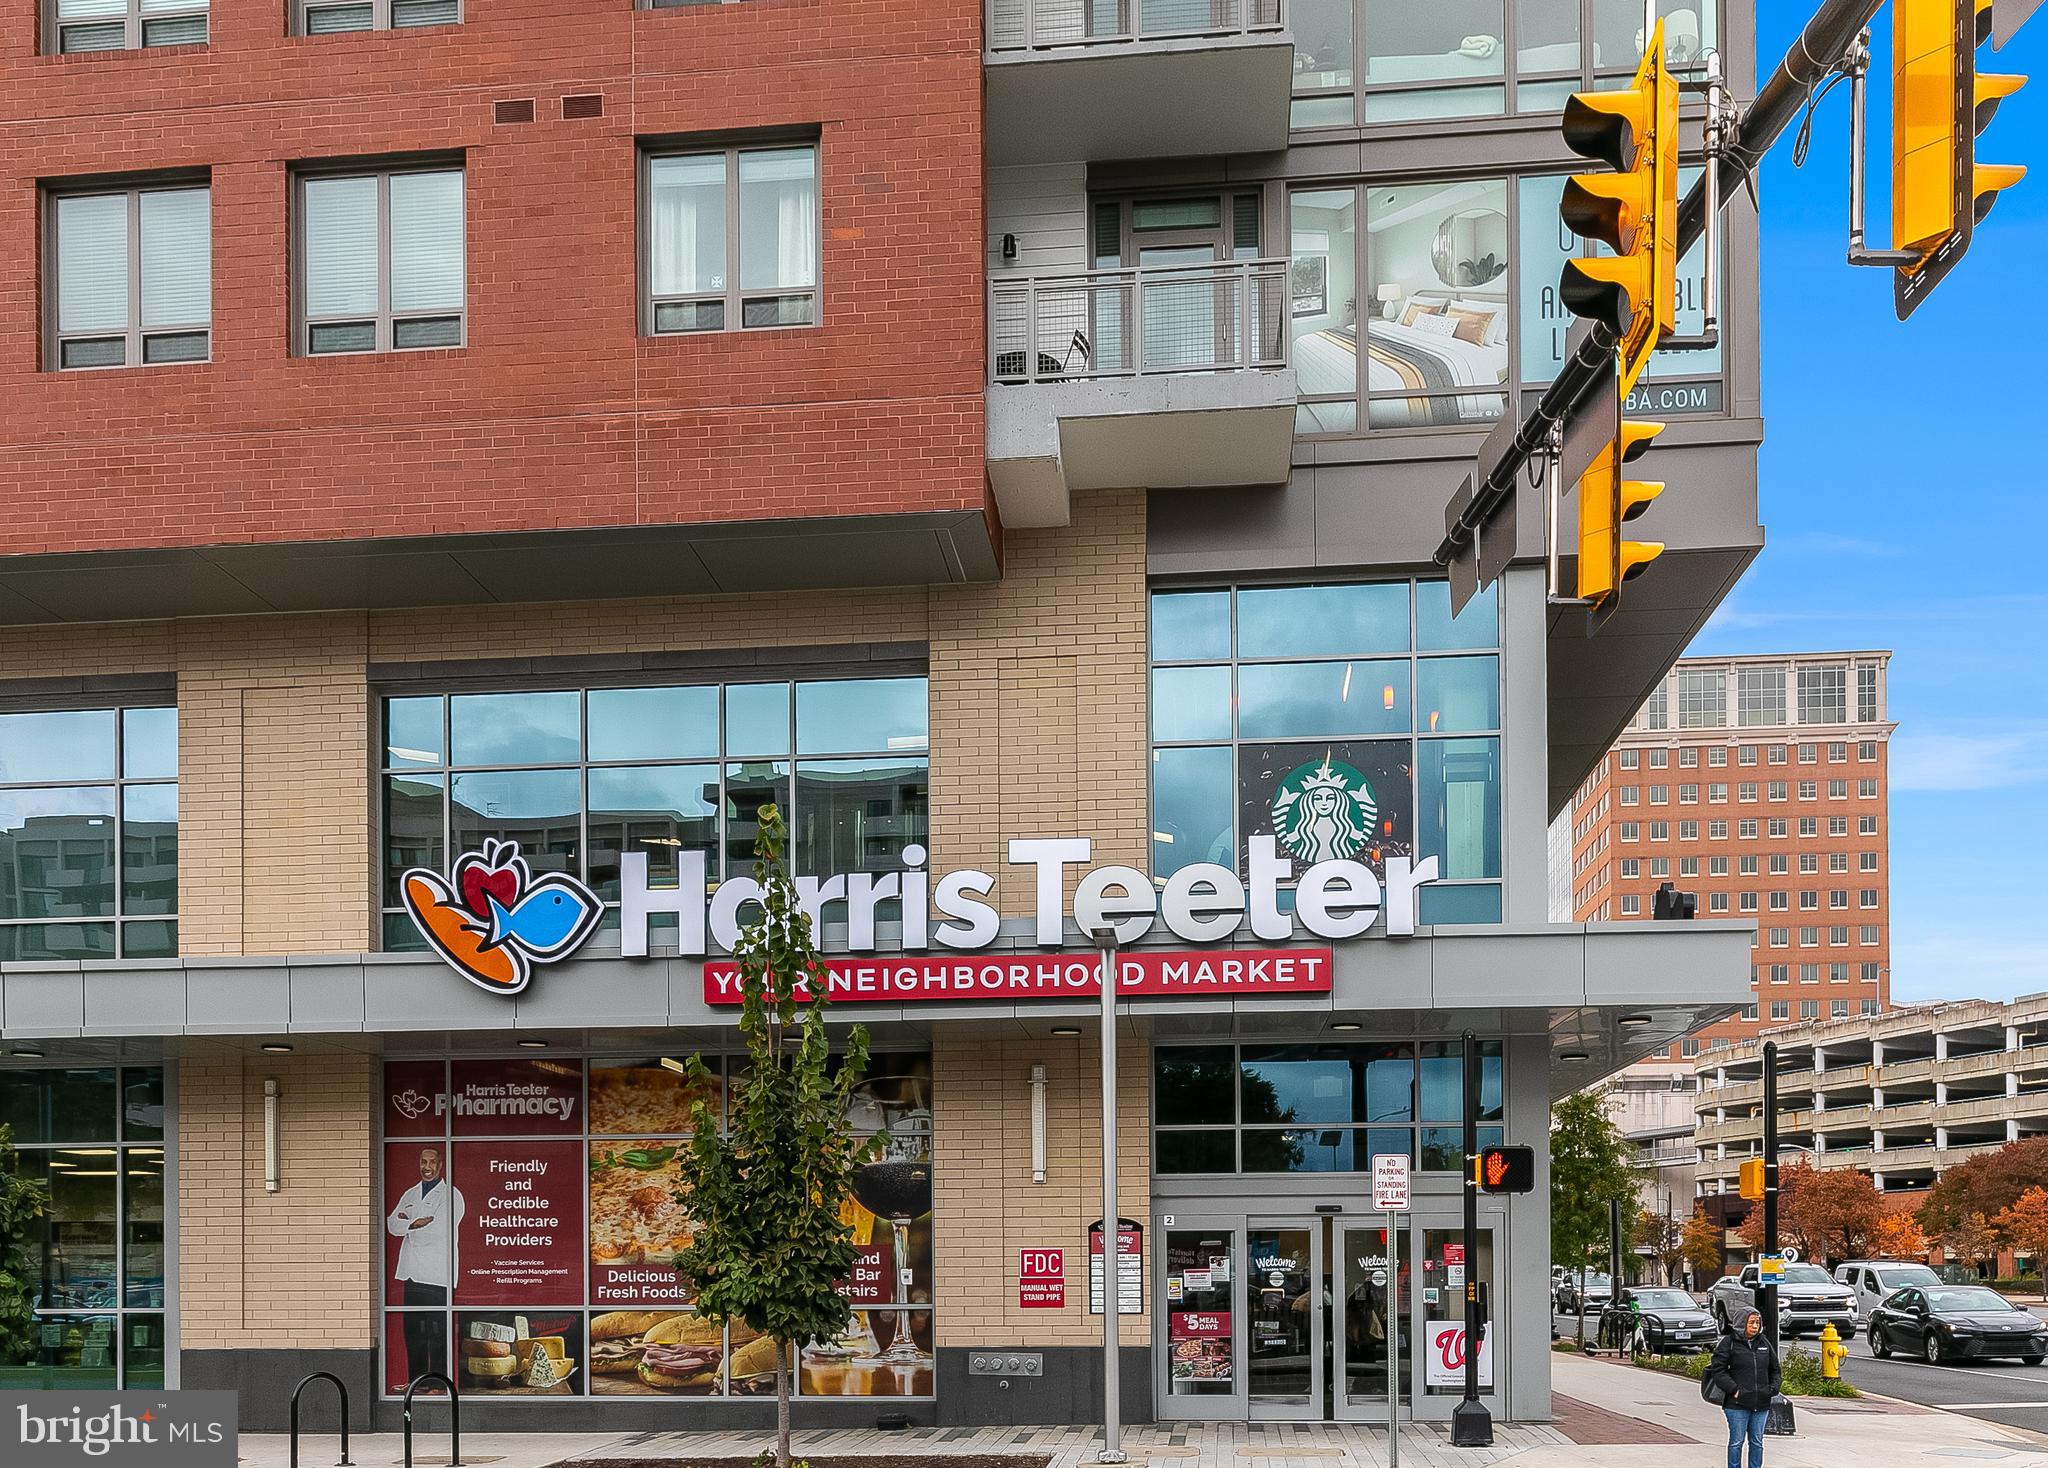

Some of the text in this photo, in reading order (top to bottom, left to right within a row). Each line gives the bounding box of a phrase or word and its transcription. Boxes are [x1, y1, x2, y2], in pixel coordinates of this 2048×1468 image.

[1625, 388, 1707, 411] BA.COM
[620, 835, 1439, 957] Harris Teeter
[1162, 957, 1323, 985] MARKET
[466, 1083, 549, 1096] Harris Teeter
[434, 1093, 575, 1121] Pharmacy
[490, 1160, 548, 1175] Friendly
[1386, 1159, 1396, 1167] NO
[505, 1178, 532, 1191] and
[1376, 1190, 1407, 1199] FIRE LANE
[488, 1196, 549, 1209] Credible
[479, 1215, 559, 1228] Healthcare
[485, 1233, 553, 1246] Providers
[1023, 1253, 1060, 1273] FDC
[1255, 1255, 1296, 1269] Welcome
[1358, 1254, 1400, 1268] Welco
[528, 1268, 568, 1276] Management
[607, 1269, 676, 1283] Delicious
[856, 1268, 881, 1281] Bar
[597, 1286, 687, 1298] Fresh Foods
[834, 1284, 878, 1297] stairs
[1183, 1314, 1199, 1330] $5
